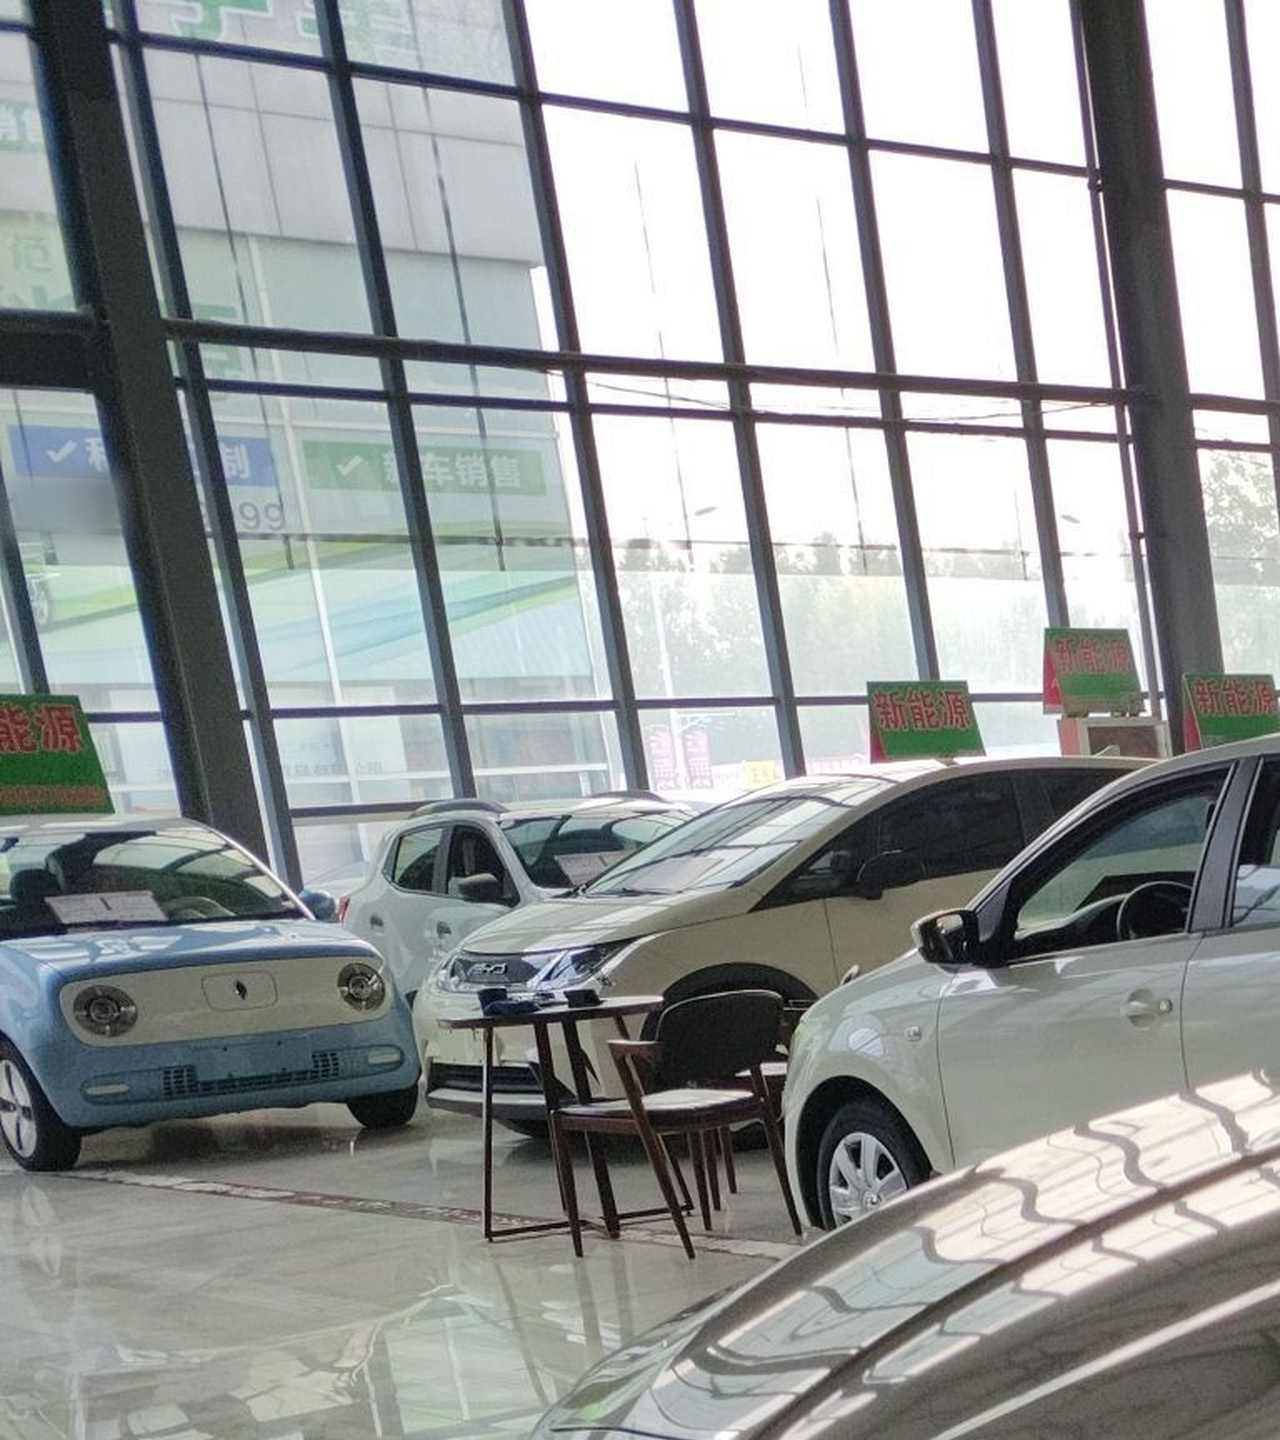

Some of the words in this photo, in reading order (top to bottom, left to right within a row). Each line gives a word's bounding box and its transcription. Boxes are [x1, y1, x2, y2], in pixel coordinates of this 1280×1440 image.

[875, 688, 971, 730] 新能源
[1194, 680, 1276, 716] 新能源
[0, 702, 84, 753] 能源
